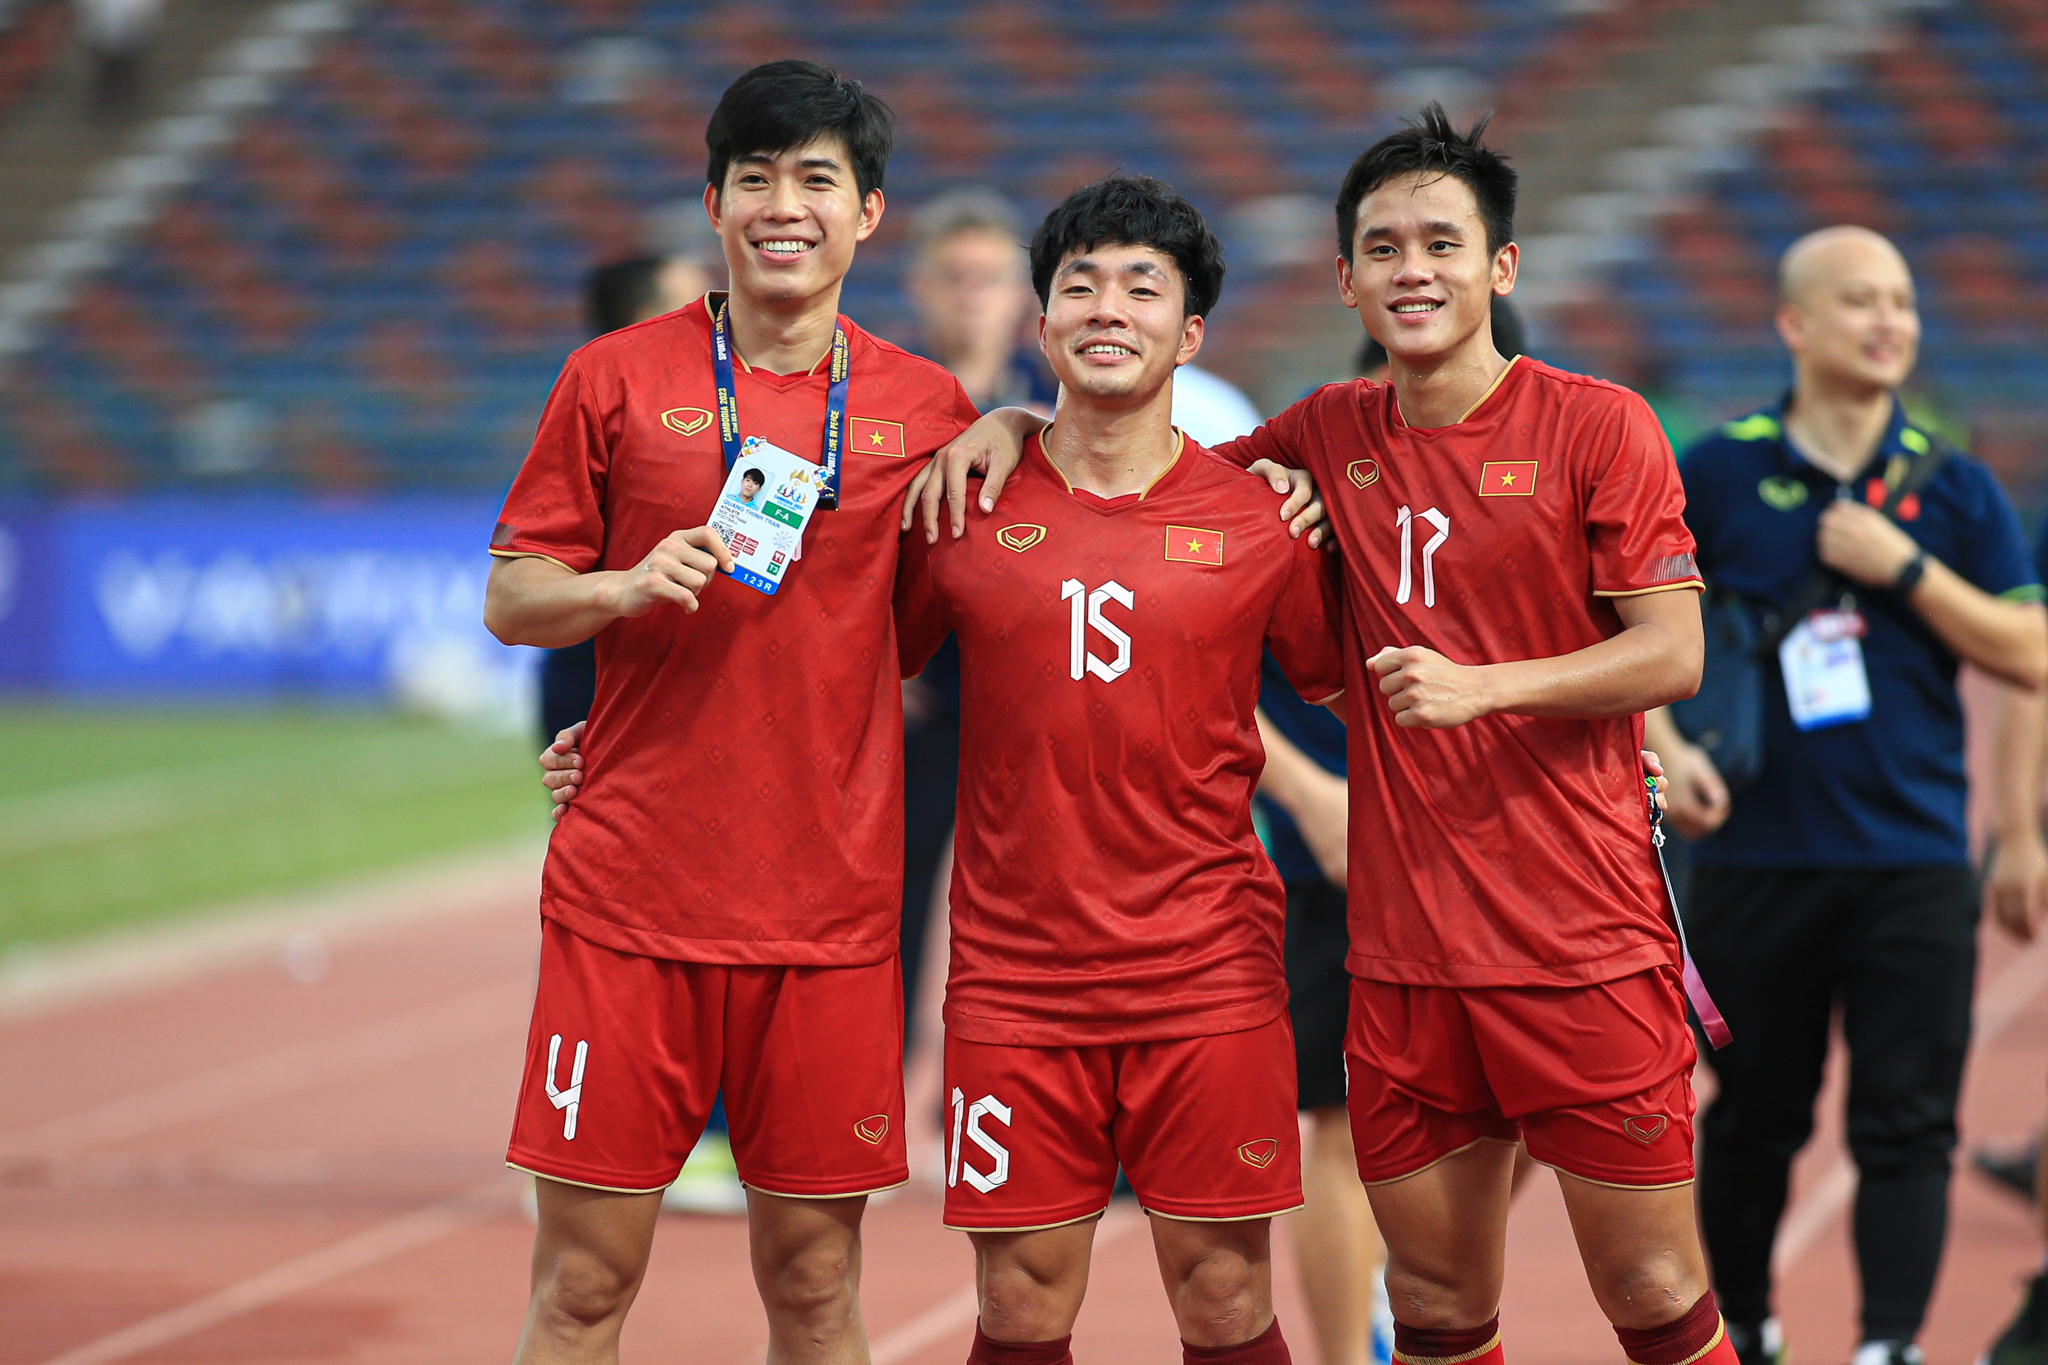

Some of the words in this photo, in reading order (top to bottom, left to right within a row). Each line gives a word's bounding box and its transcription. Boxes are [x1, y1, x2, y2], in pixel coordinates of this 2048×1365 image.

[716, 335, 727, 361] SPORTS
[834, 329, 844, 347] 2023
[831, 347, 843, 383] CAMBODIA
[717, 387, 728, 405] 2023
[719, 405, 733, 442] CAMBODIA
[829, 409, 840, 430] PEACE
[829, 429, 838, 438] IN
[717, 513, 738, 525] FOOTBALL
[720, 505, 740, 516] ATHLETE
[723, 499, 745, 512] QUANG
[745, 509, 764, 521] THINH
[764, 517, 781, 529] TRAN
[774, 508, 789, 521] F-A
[1395, 504, 1450, 608] 17
[769, 564, 779, 573] T3
[1060, 577, 1135, 684] 15
[544, 1033, 590, 1141] 4
[947, 1086, 1012, 1194] 15
